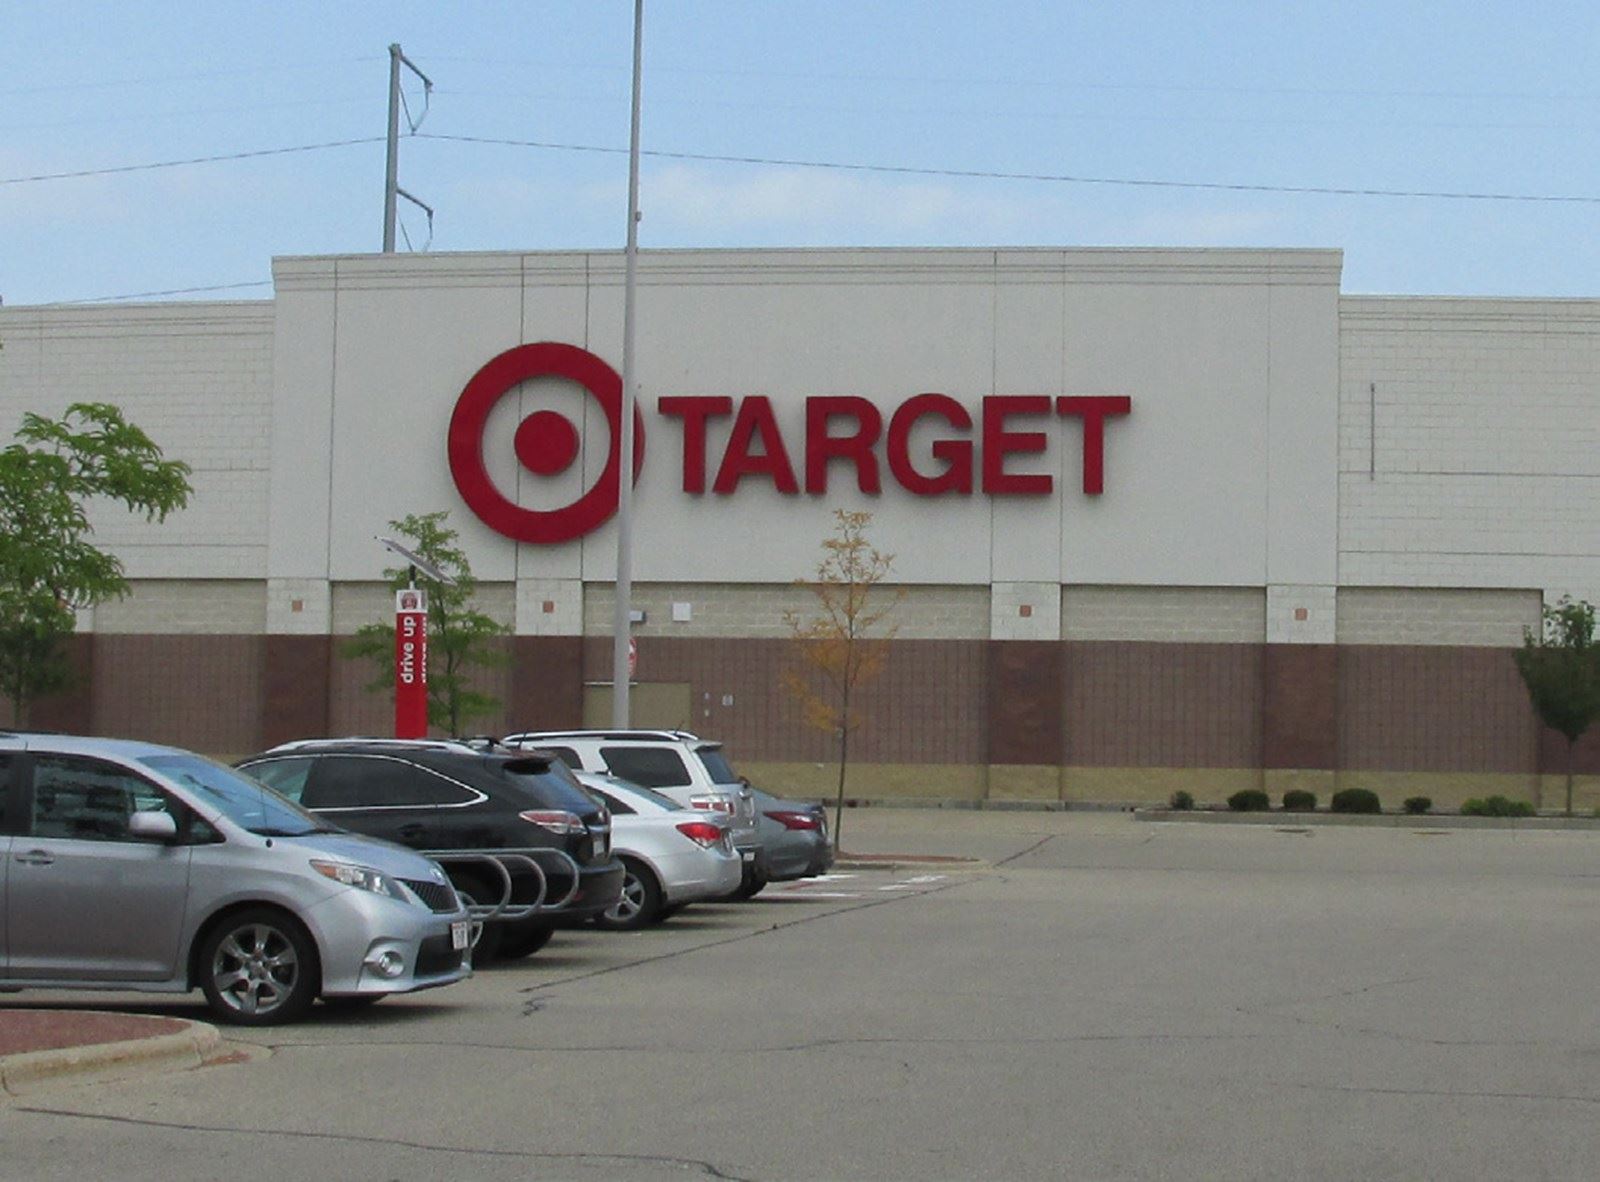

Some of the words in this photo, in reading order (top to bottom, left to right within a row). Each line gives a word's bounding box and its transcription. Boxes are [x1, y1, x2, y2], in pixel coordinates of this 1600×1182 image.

[658, 393, 1131, 495] TARGET
[403, 616, 416, 637] up
[400, 642, 414, 683] drive
